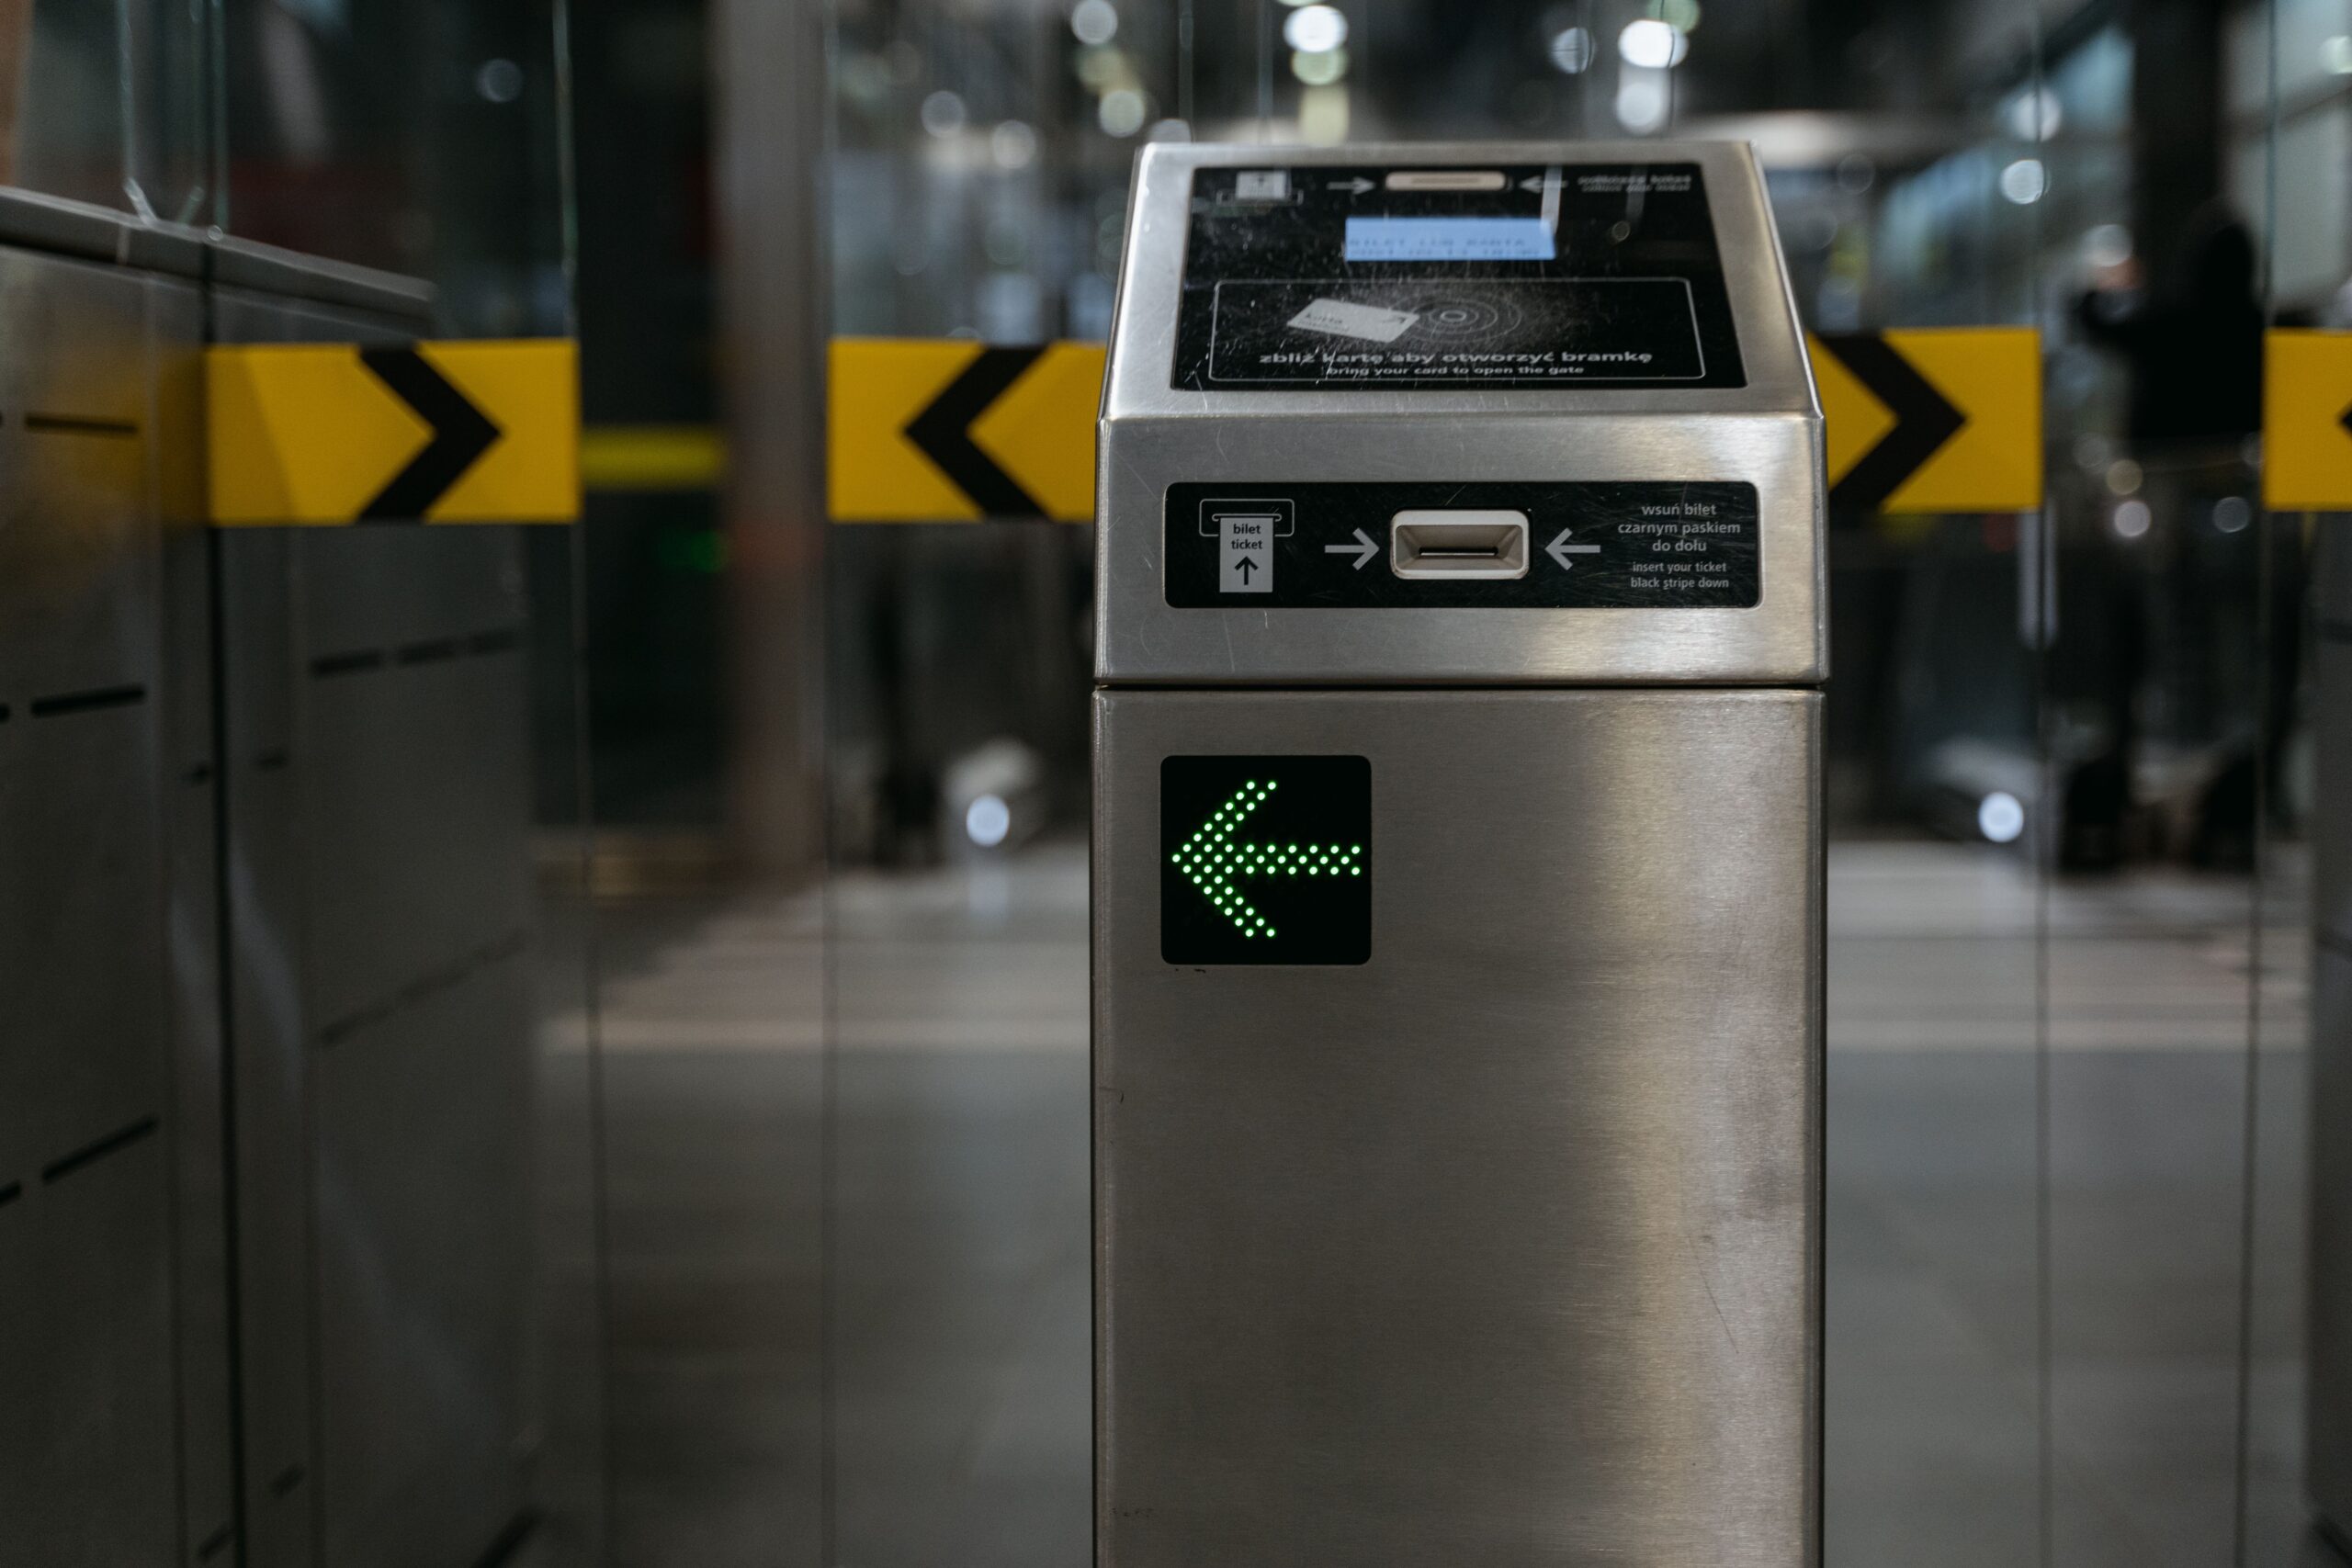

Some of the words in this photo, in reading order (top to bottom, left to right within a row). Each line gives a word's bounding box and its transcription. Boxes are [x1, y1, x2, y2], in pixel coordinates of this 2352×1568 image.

[1260, 352, 1316, 364] zbliż
[1322, 352, 1384, 365] kartę
[1391, 353, 1434, 364] aby
[1442, 351, 1555, 364] otworzyć
[1562, 351, 1653, 364] bramkę
[1327, 367, 1369, 376] bring
[1375, 367, 1409, 376] your
[1414, 367, 1448, 375] card
[1453, 367, 1469, 375] to
[1474, 367, 1513, 376] open
[1518, 367, 1544, 375] the
[1548, 367, 1585, 376] gate
[1642, 502, 1679, 515] wsuń
[1684, 502, 1717, 515] bilet
[1233, 523, 1261, 535] bilet
[1618, 524, 1678, 536] czarnym
[1682, 521, 1741, 536] paskiem
[1231, 538, 1263, 550] ticket
[1652, 539, 1671, 551] do
[1675, 539, 1708, 551] dołu
[1633, 561, 1664, 572] insert
[1667, 562, 1691, 574] your
[1695, 561, 1726, 572] ticket
[1631, 577, 1659, 588] black
[1663, 577, 1695, 590] stripe
[1698, 577, 1729, 588] down
